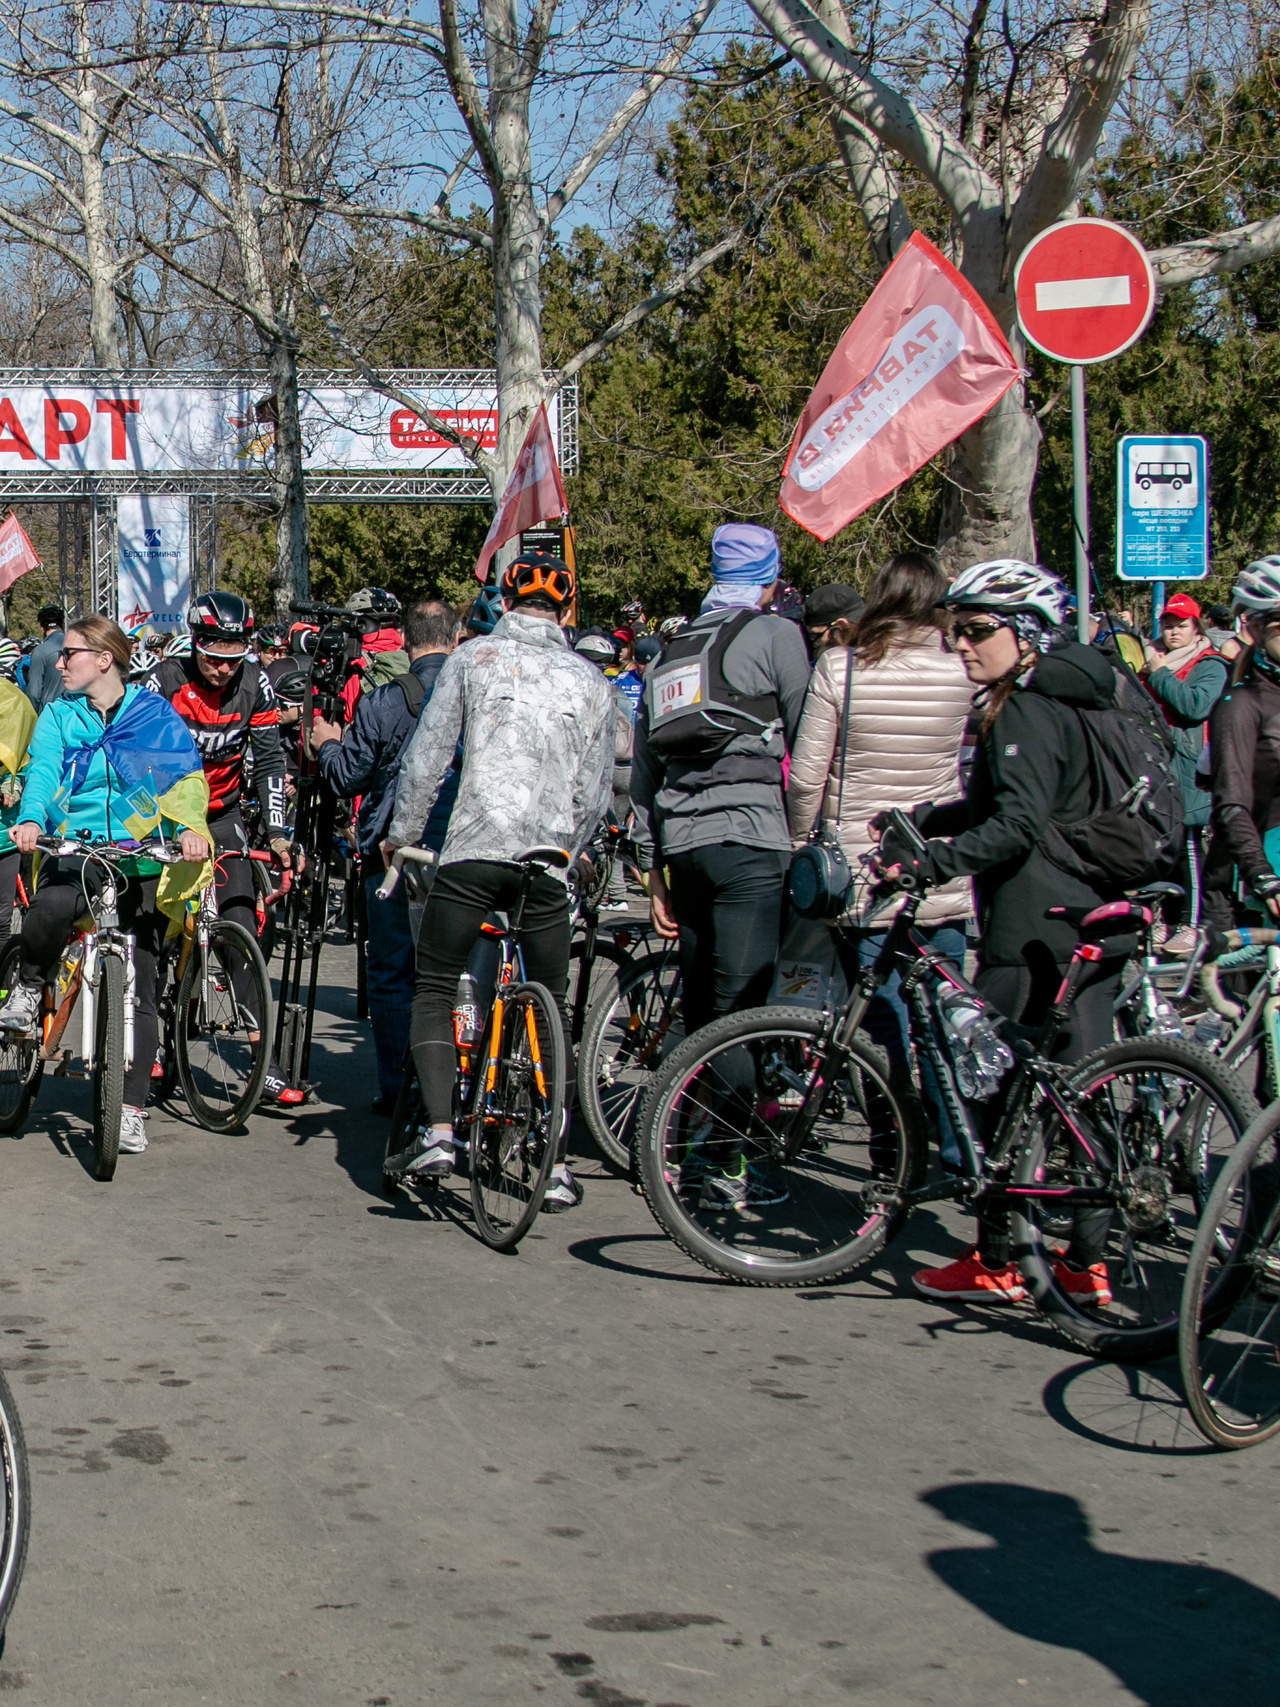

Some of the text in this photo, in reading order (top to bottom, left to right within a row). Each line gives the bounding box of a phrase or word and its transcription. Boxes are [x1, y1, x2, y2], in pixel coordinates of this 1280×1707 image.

[123, 549, 182, 560] Евротерминал
[152, 613, 183, 622] VELO
[660, 681, 684, 704] 101
[267, 776, 284, 829] BMC
